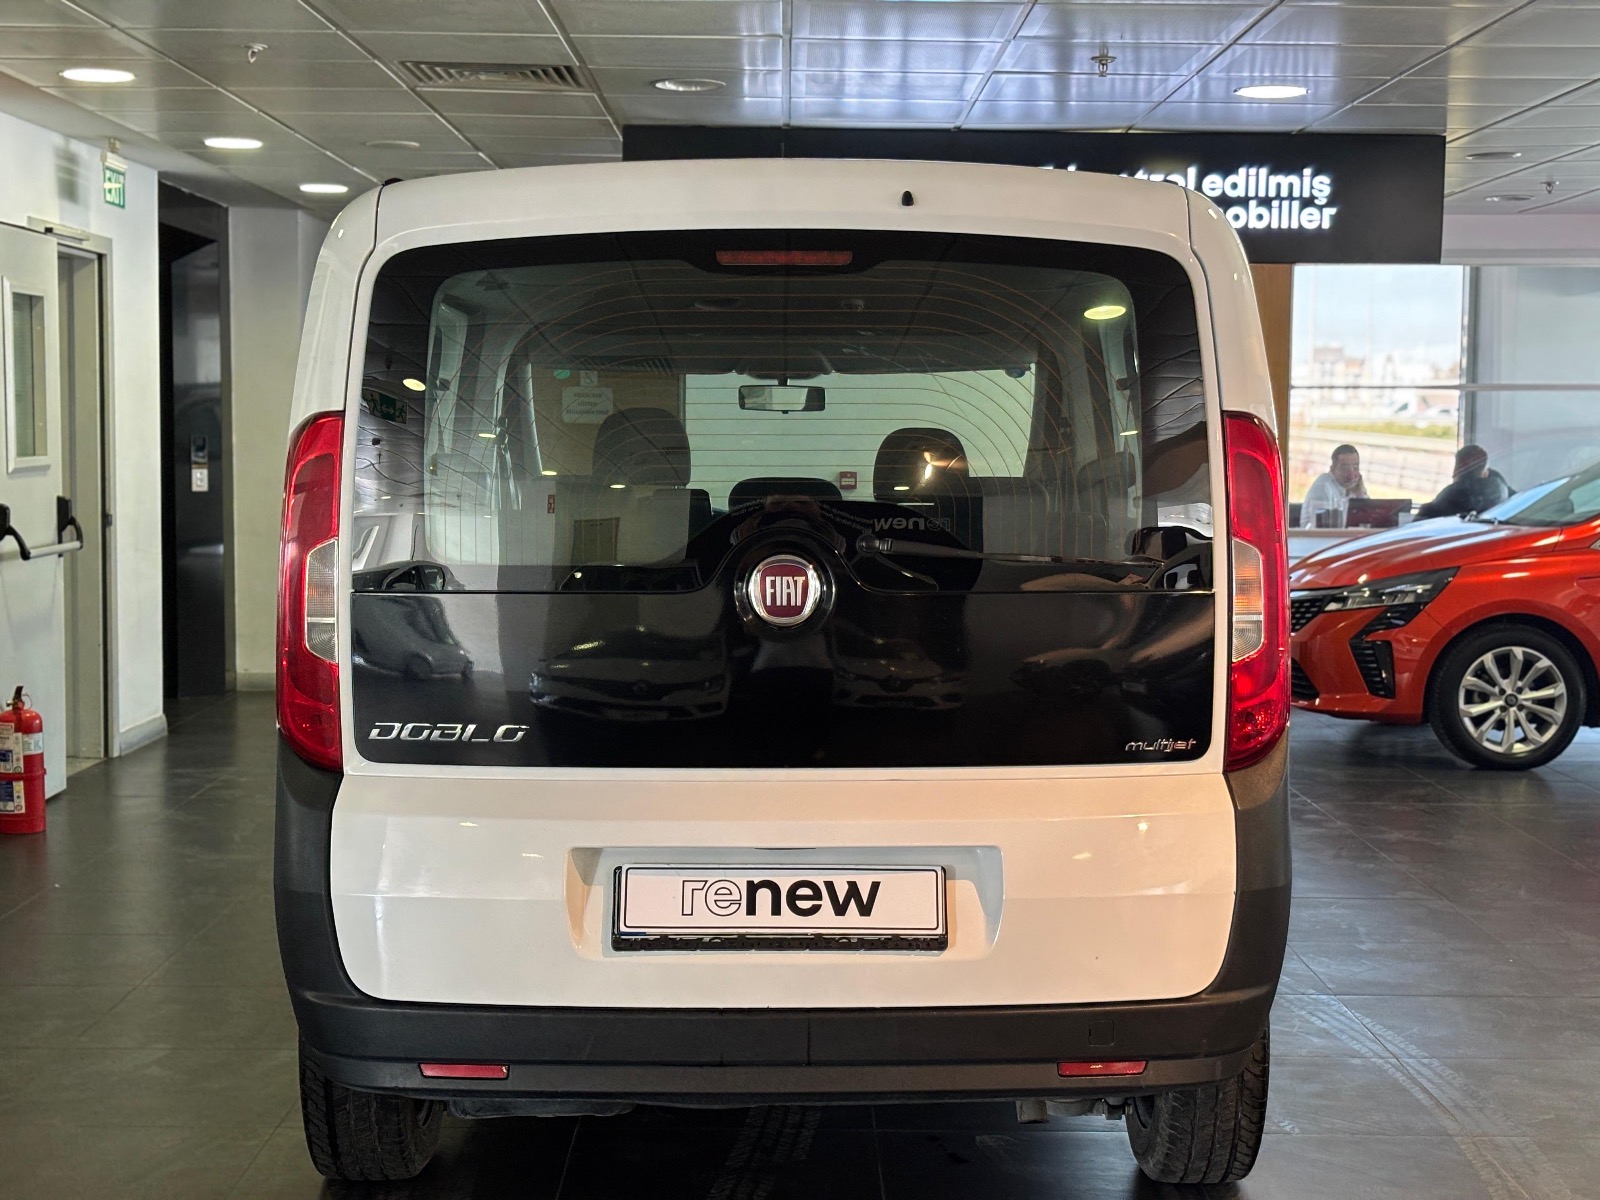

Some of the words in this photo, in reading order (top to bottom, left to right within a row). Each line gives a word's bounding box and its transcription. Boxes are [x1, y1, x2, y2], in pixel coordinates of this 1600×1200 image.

[1201, 167, 1331, 205] edilmiş
[1219, 199, 1337, 229] obiller
[765, 576, 805, 606] FIAT
[1125, 738, 1197, 752] multijet
[681, 879, 881, 917] renew
